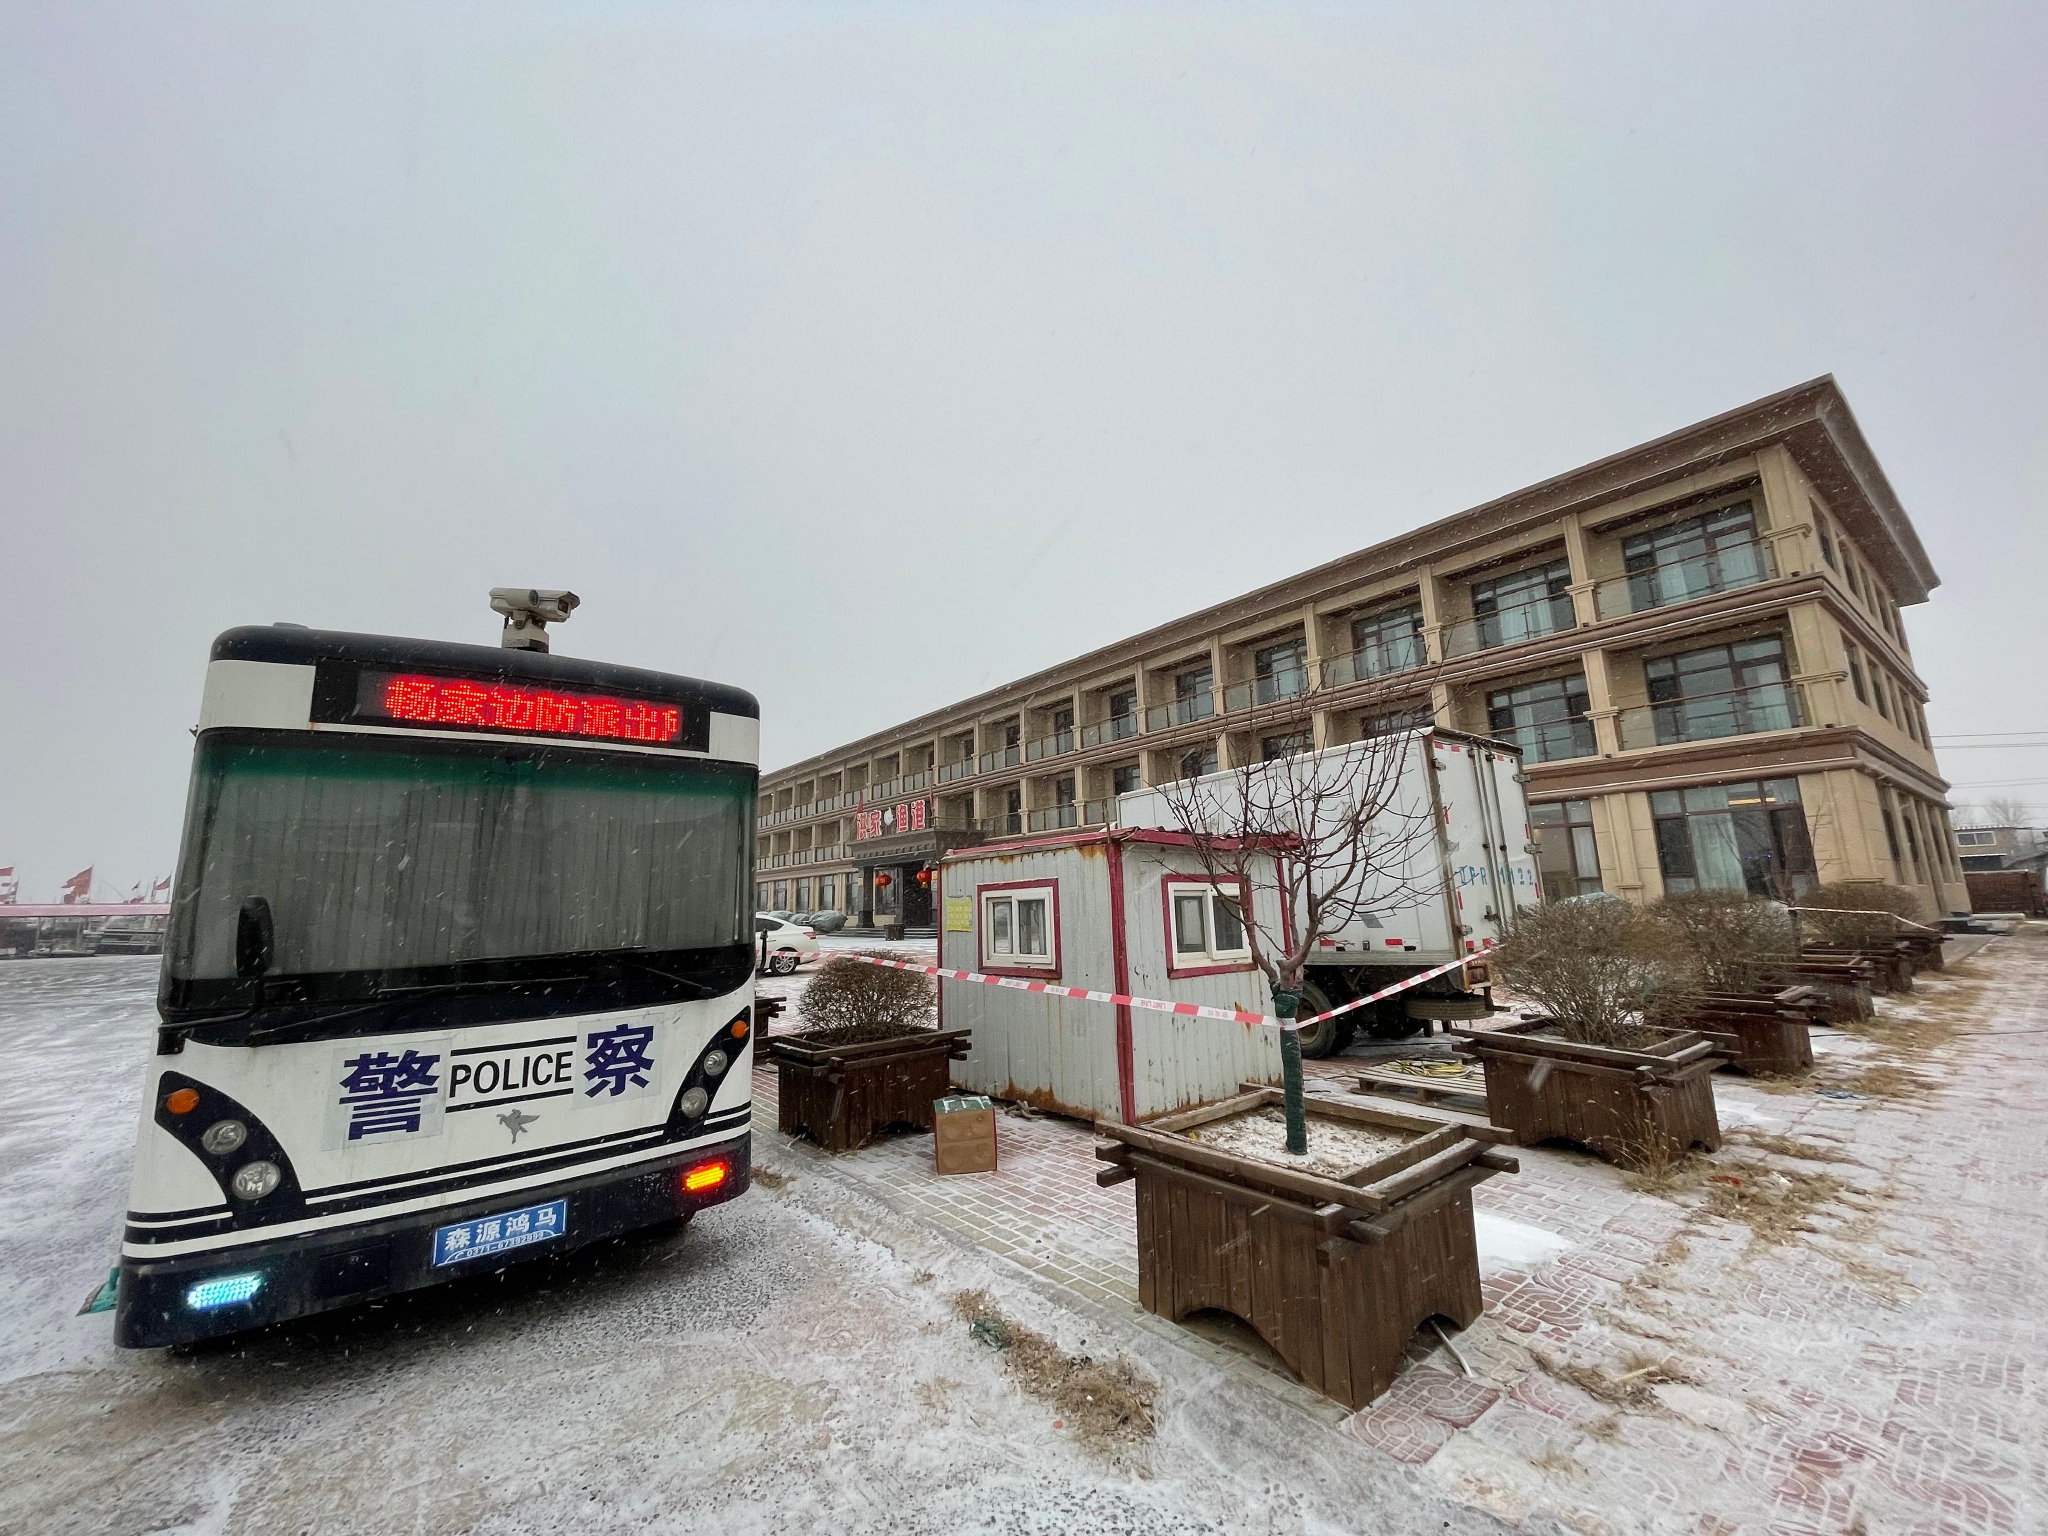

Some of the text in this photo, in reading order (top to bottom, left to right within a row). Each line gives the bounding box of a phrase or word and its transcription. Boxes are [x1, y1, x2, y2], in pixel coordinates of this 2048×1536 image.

[339, 1023, 655, 1141] 警 POLICE 察
[444, 1207, 557, 1251] 森源鸿马
